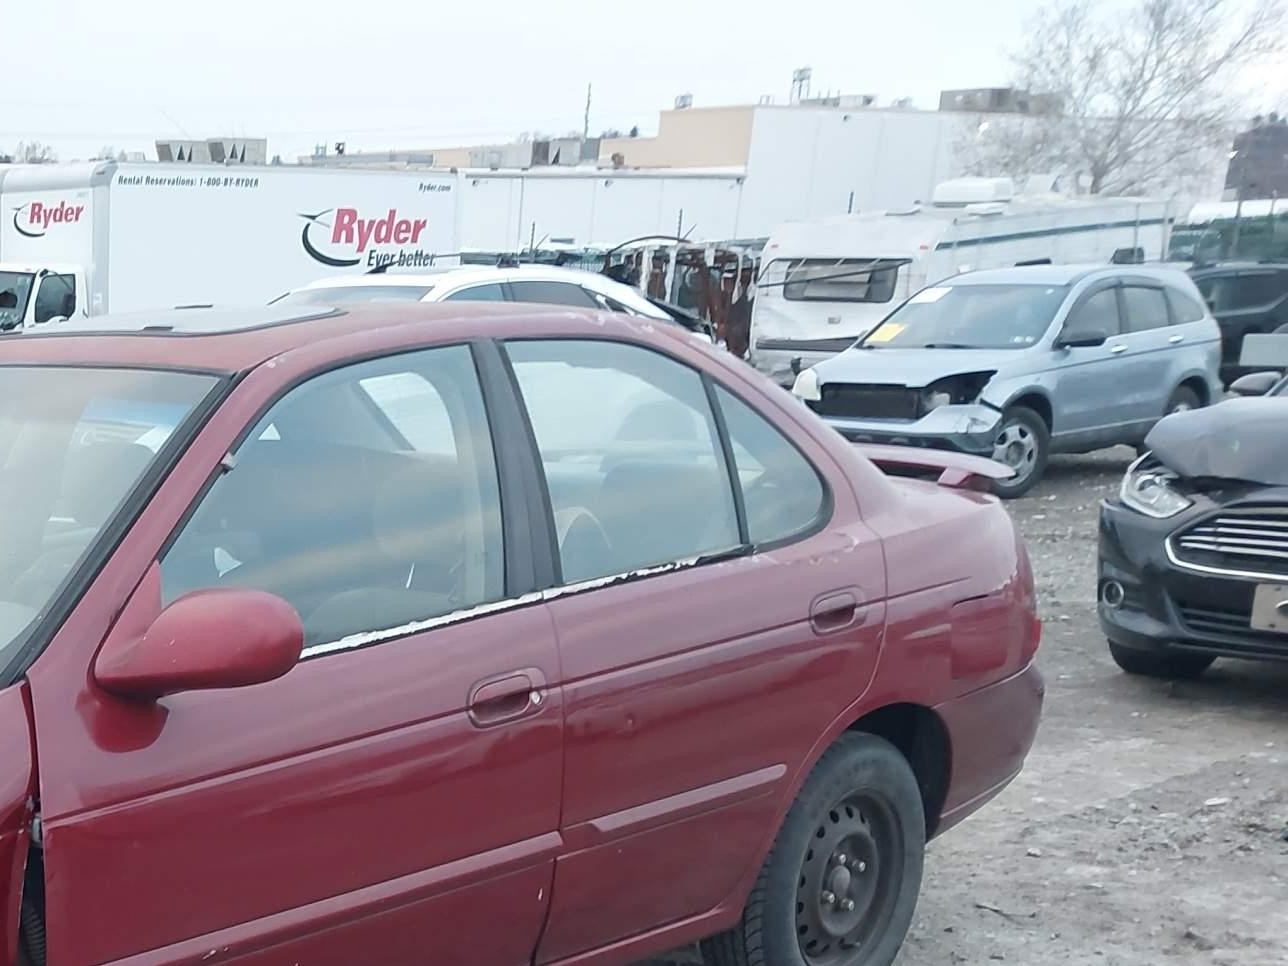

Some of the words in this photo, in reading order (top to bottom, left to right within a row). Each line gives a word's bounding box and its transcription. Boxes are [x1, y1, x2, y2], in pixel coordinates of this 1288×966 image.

[118, 175, 142, 185] Rental
[145, 175, 197, 186] Reservations:
[199, 176, 259, 188] 1-800-BY-RYDER
[418, 182, 451, 193] Ryder.com
[29, 200, 84, 228] Ryder
[331, 207, 427, 252] Ryder
[367, 249, 396, 267] Ever
